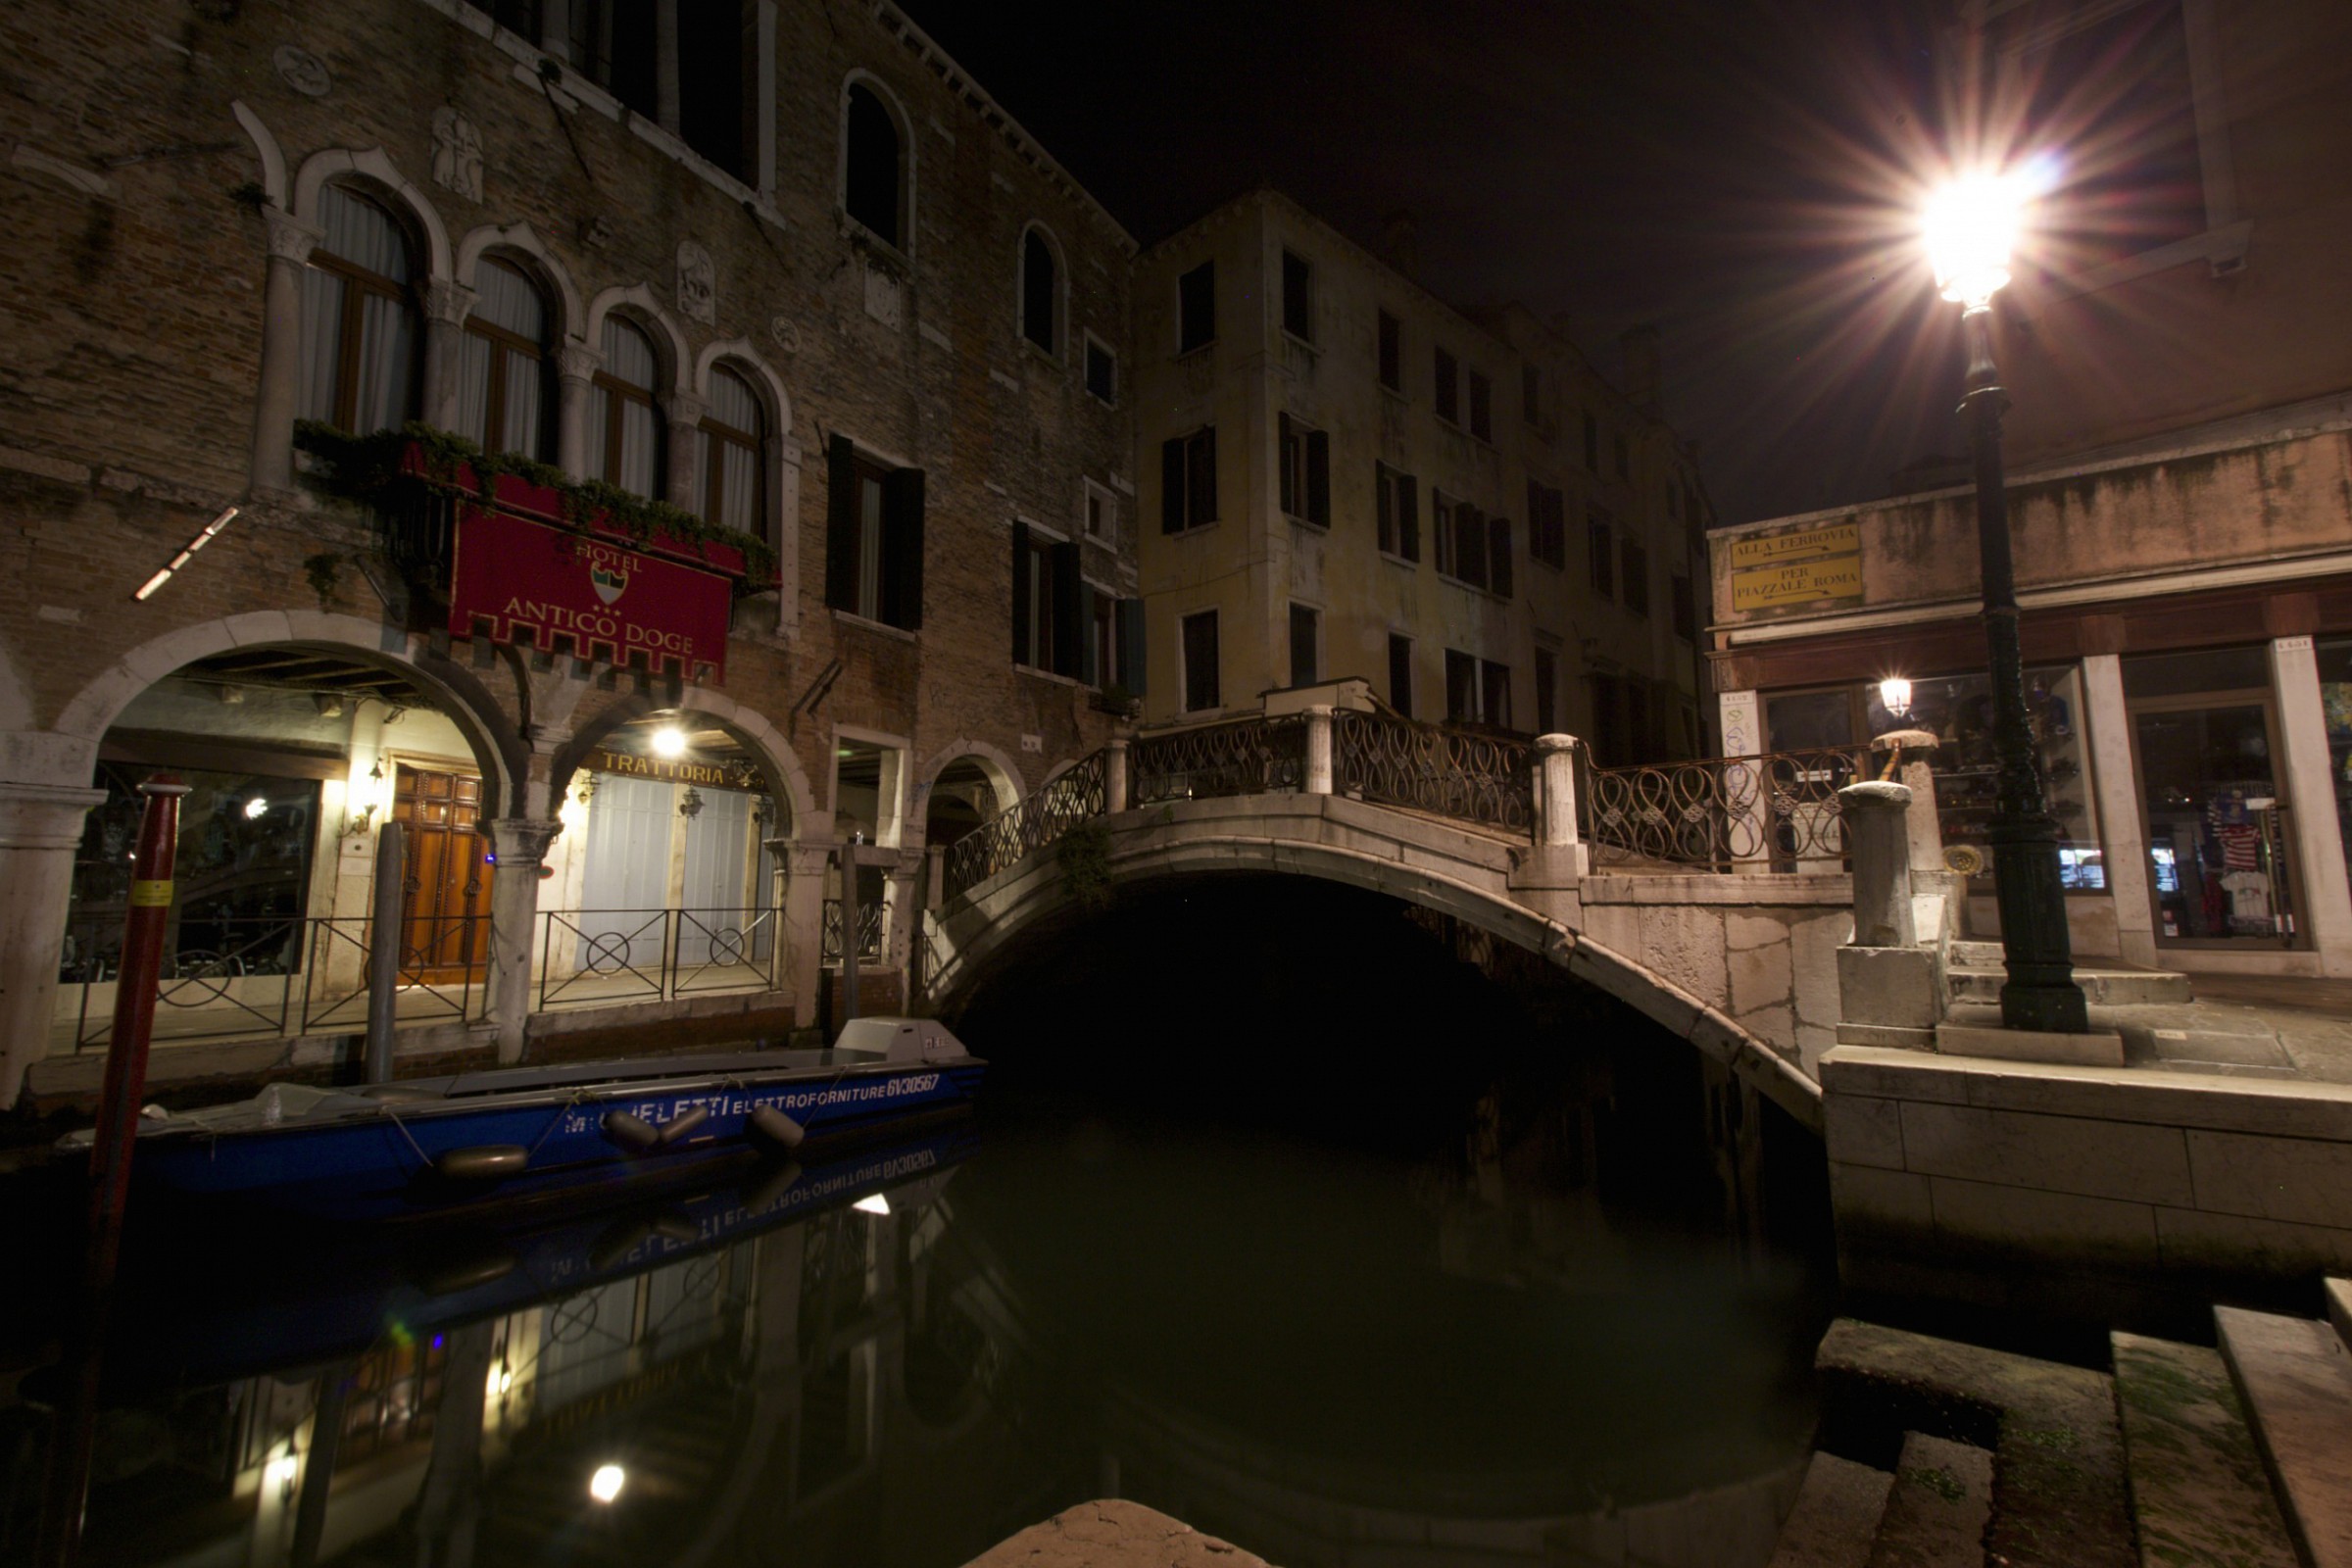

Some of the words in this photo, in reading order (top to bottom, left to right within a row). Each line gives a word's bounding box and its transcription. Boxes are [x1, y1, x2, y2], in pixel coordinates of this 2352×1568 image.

[1736, 541, 1773, 557] ALLA
[1780, 527, 1855, 550] FERROVIA
[575, 544, 643, 573] HOTEL
[1781, 566, 1809, 580] PER
[1737, 579, 1807, 598] PIAZZALE
[1813, 572, 1858, 587] ROMA
[503, 596, 617, 636] ANTICO
[625, 622, 693, 655] DOGE
[602, 752, 724, 785] TRATTORIA
